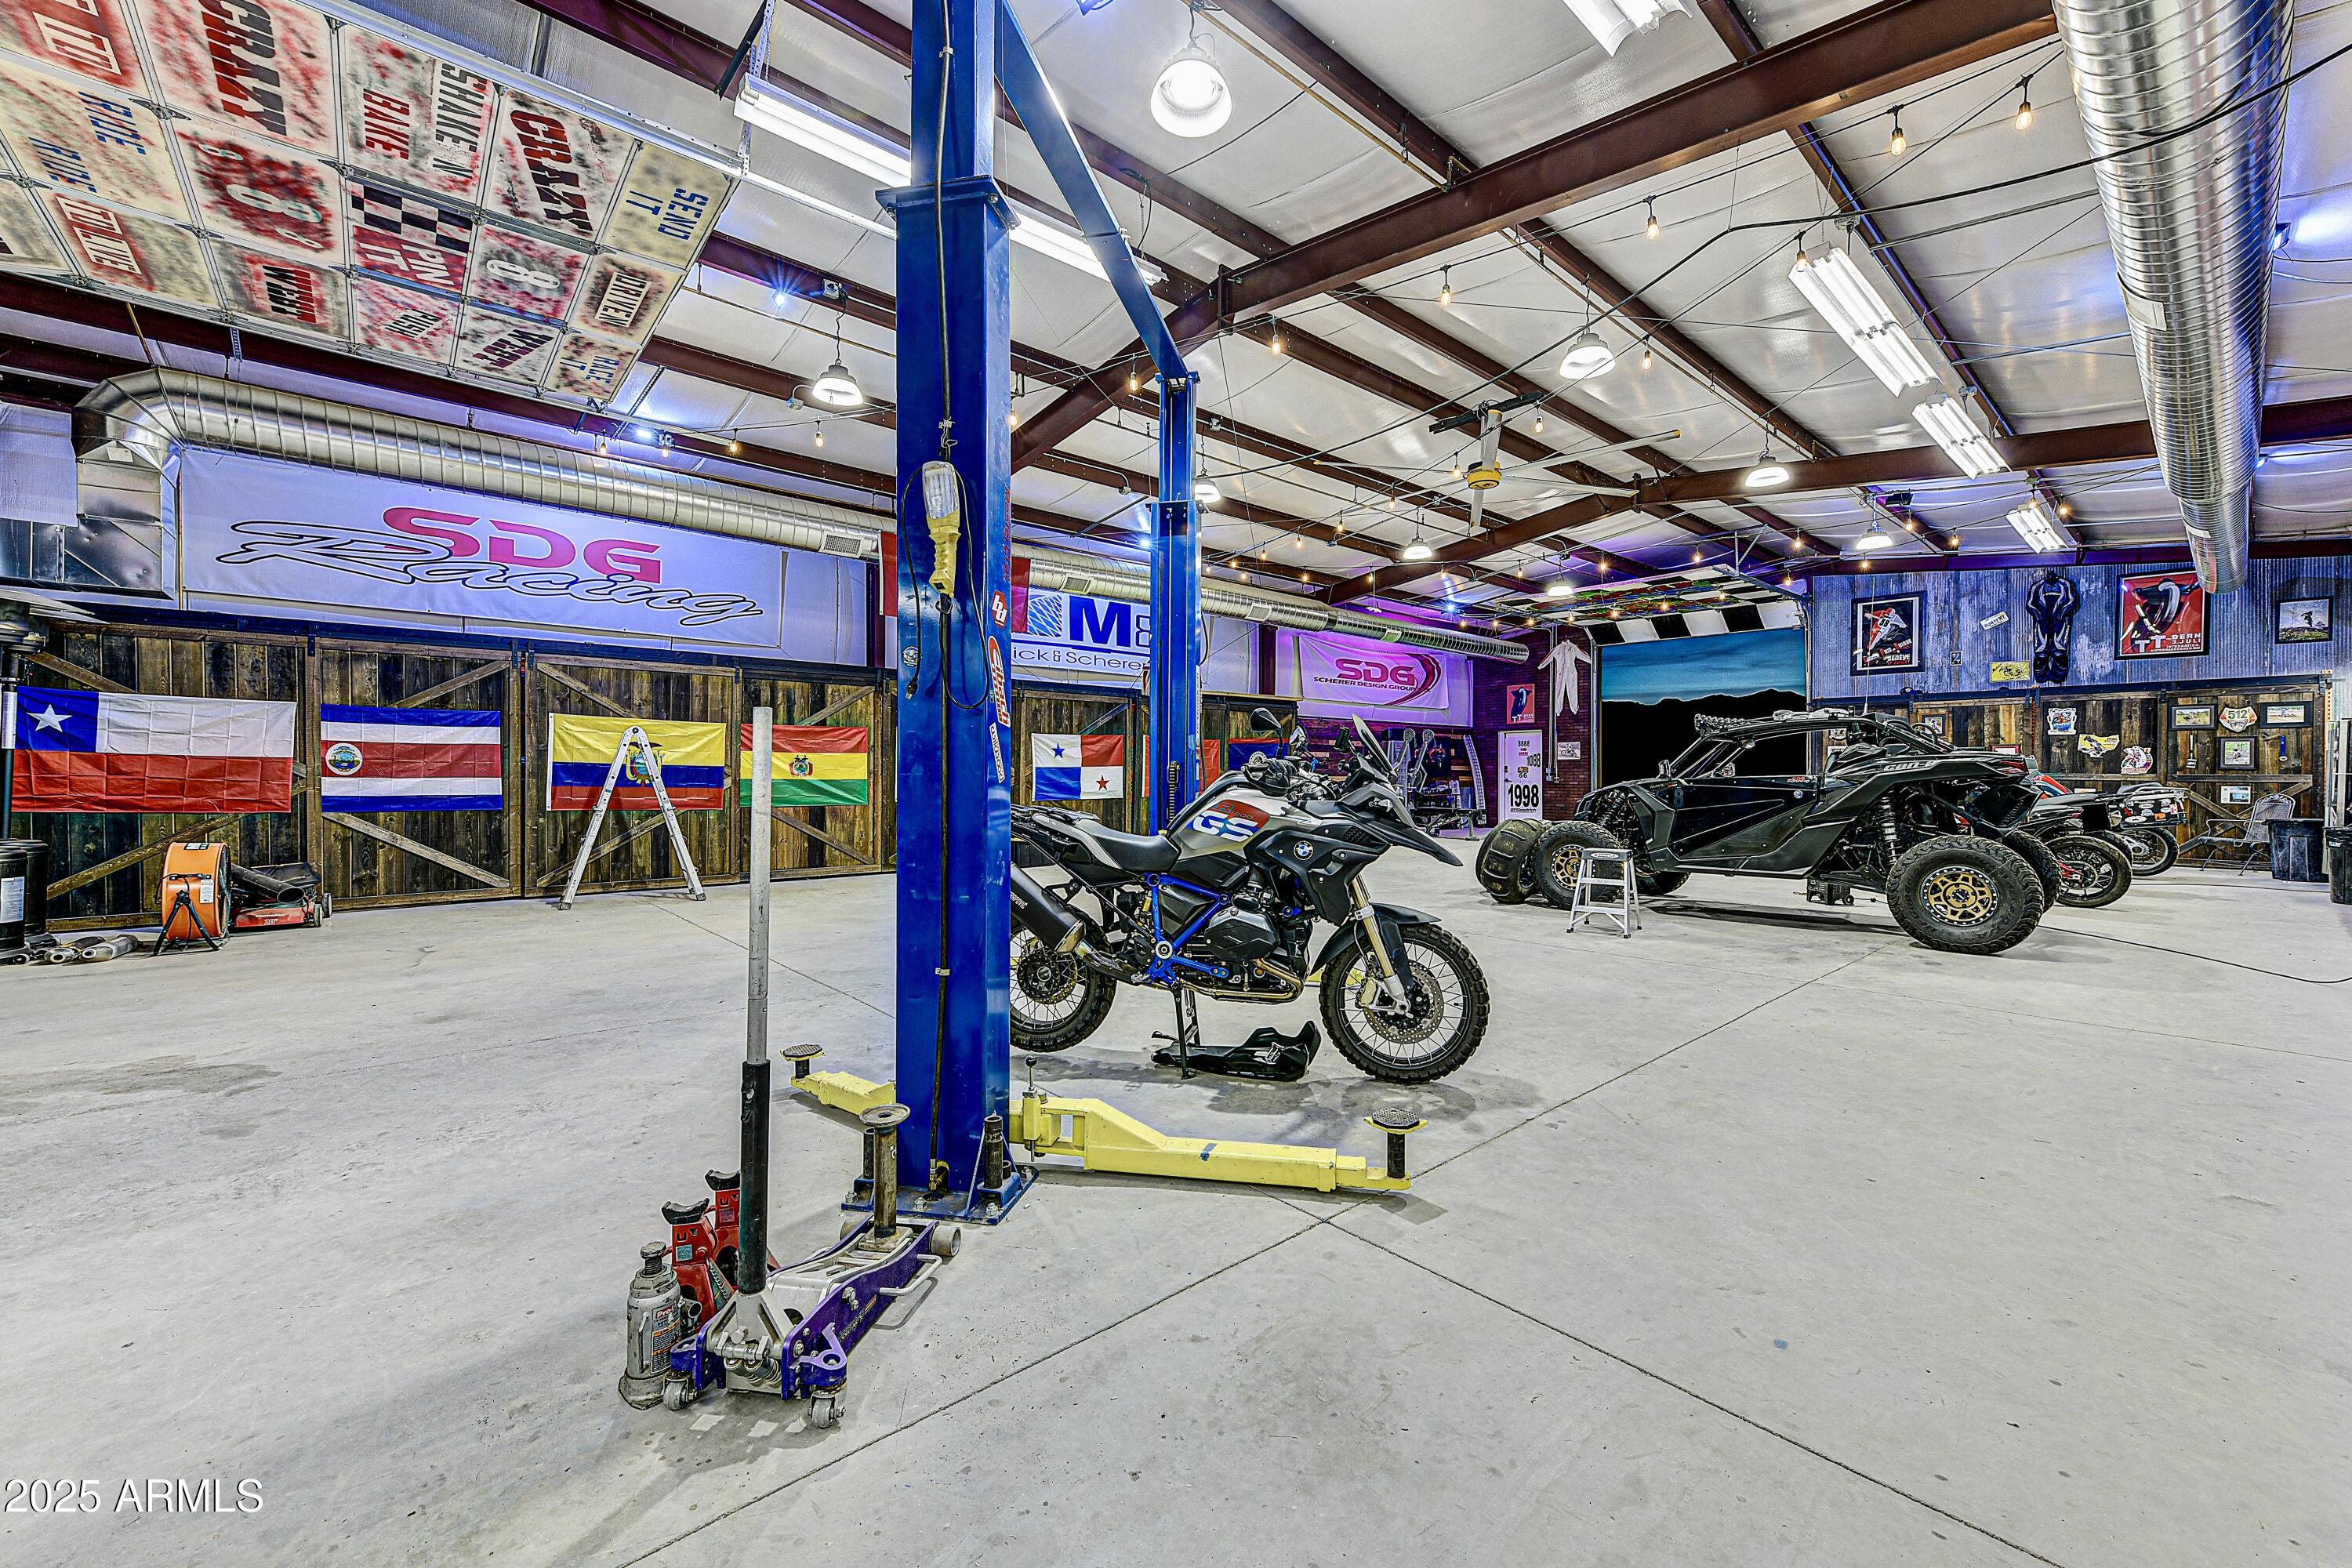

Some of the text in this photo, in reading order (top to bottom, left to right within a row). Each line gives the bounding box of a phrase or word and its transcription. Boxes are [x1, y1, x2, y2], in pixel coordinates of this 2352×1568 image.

[198, 0, 288, 136] CRAZY
[78, 91, 146, 155] RIDE
[363, 88, 410, 160] BAKE
[432, 63, 488, 179] SHAKE N
[28, 136, 97, 194] RIDE
[510, 109, 593, 231] CRAZY
[227, 183, 323, 223] 8
[625, 190, 662, 216] IT
[658, 187, 710, 240] SEND
[65, 202, 136, 272] TO LIVE
[358, 241, 405, 270] IT
[401, 243, 453, 287] PIN
[485, 259, 561, 289] 8
[263, 265, 316, 323] WEST
[598, 274, 649, 326] DRIVEN
[384, 312, 440, 339] PUSH
[474, 329, 554, 368] WEST
[560, 358, 587, 371] IT
[586, 356, 619, 385] RACE
[383, 506, 662, 585] SDG
[216, 521, 764, 626] Racing
[1313, 677, 1356, 686] SCHERER
[1357, 681, 1388, 689] DESIGN
[1334, 658, 1415, 686] SDG
[1508, 784, 1539, 808] 1998
[1192, 810, 1258, 842] GS
